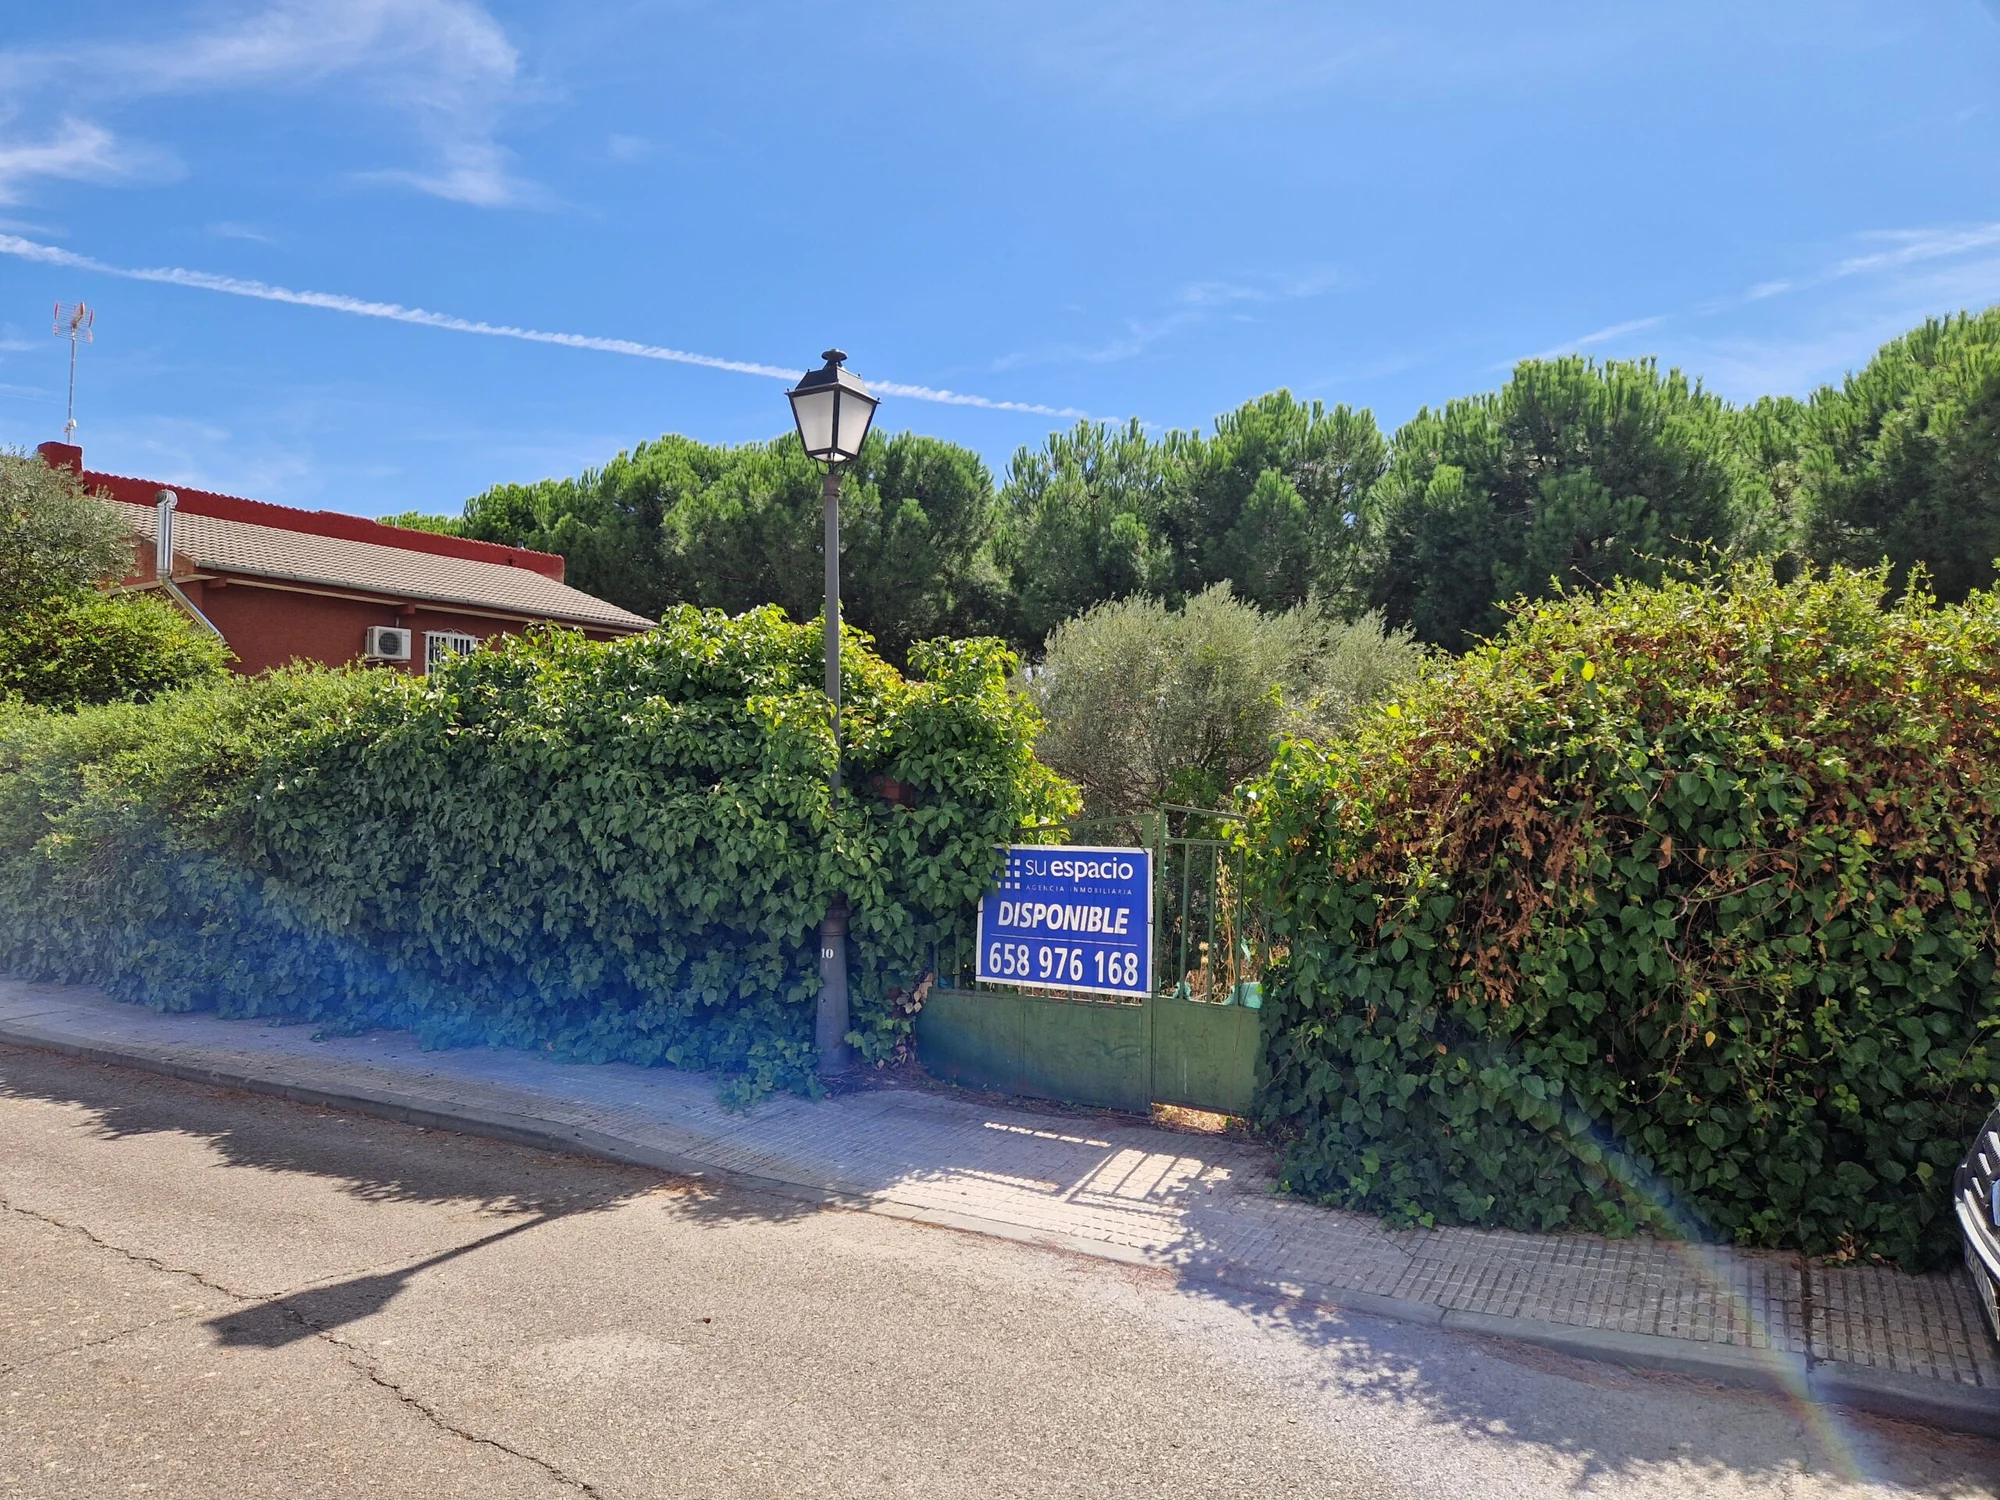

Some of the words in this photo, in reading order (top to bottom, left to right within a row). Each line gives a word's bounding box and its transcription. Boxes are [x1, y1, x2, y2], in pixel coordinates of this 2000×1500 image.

[1025, 884, 1065, 892] AGENCIA
[1070, 886, 1132, 896] INMOBILIARIA
[998, 901, 1130, 934] DISPONIBLE
[821, 947, 834, 959] 10
[989, 942, 1030, 977] 658
[1039, 946, 1083, 981] 976
[1094, 950, 1138, 986] 168
